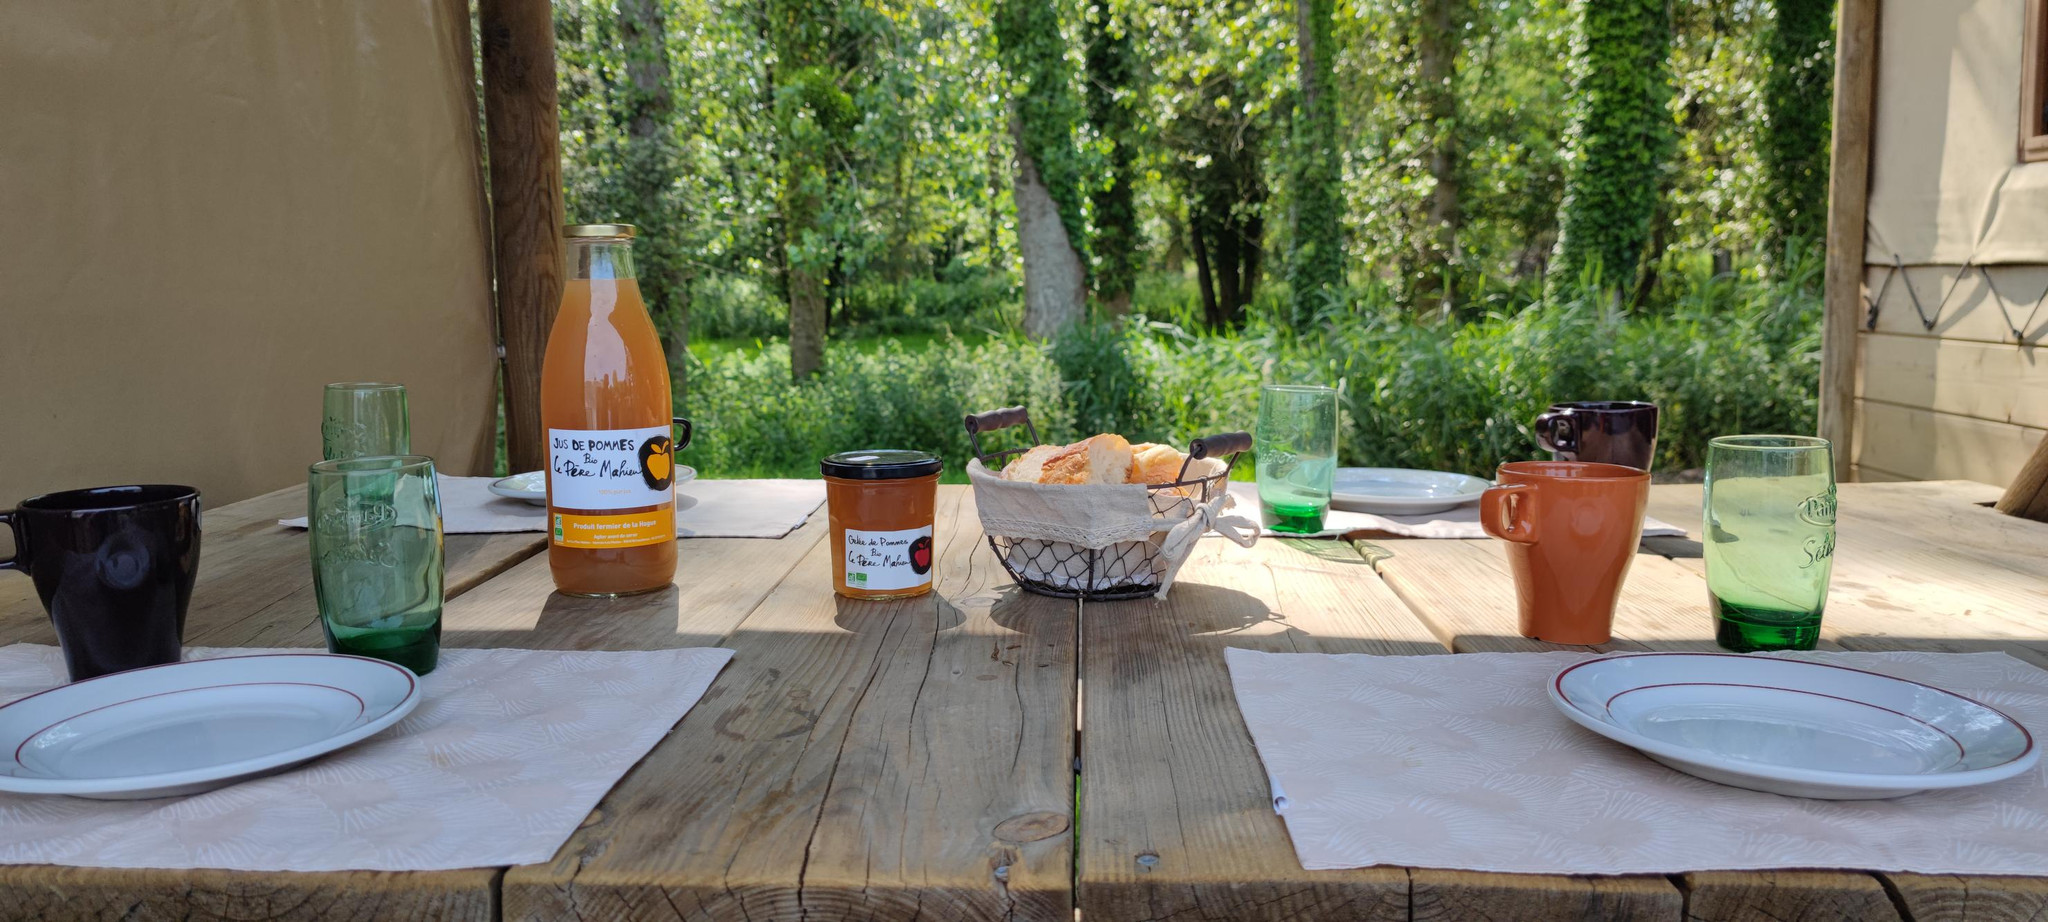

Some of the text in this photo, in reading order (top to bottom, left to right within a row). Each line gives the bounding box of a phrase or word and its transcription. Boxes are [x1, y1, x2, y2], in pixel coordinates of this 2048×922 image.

[553, 438, 635, 452] JUS DE POMMES
[583, 453, 598, 464] Bio
[553, 455, 562, 474] Le
[599, 460, 642, 480] Mahieu
[573, 522, 595, 530] Produit
[868, 538, 878, 546] de
[880, 537, 909, 547] Pommes
[870, 548, 882, 557] Bio
